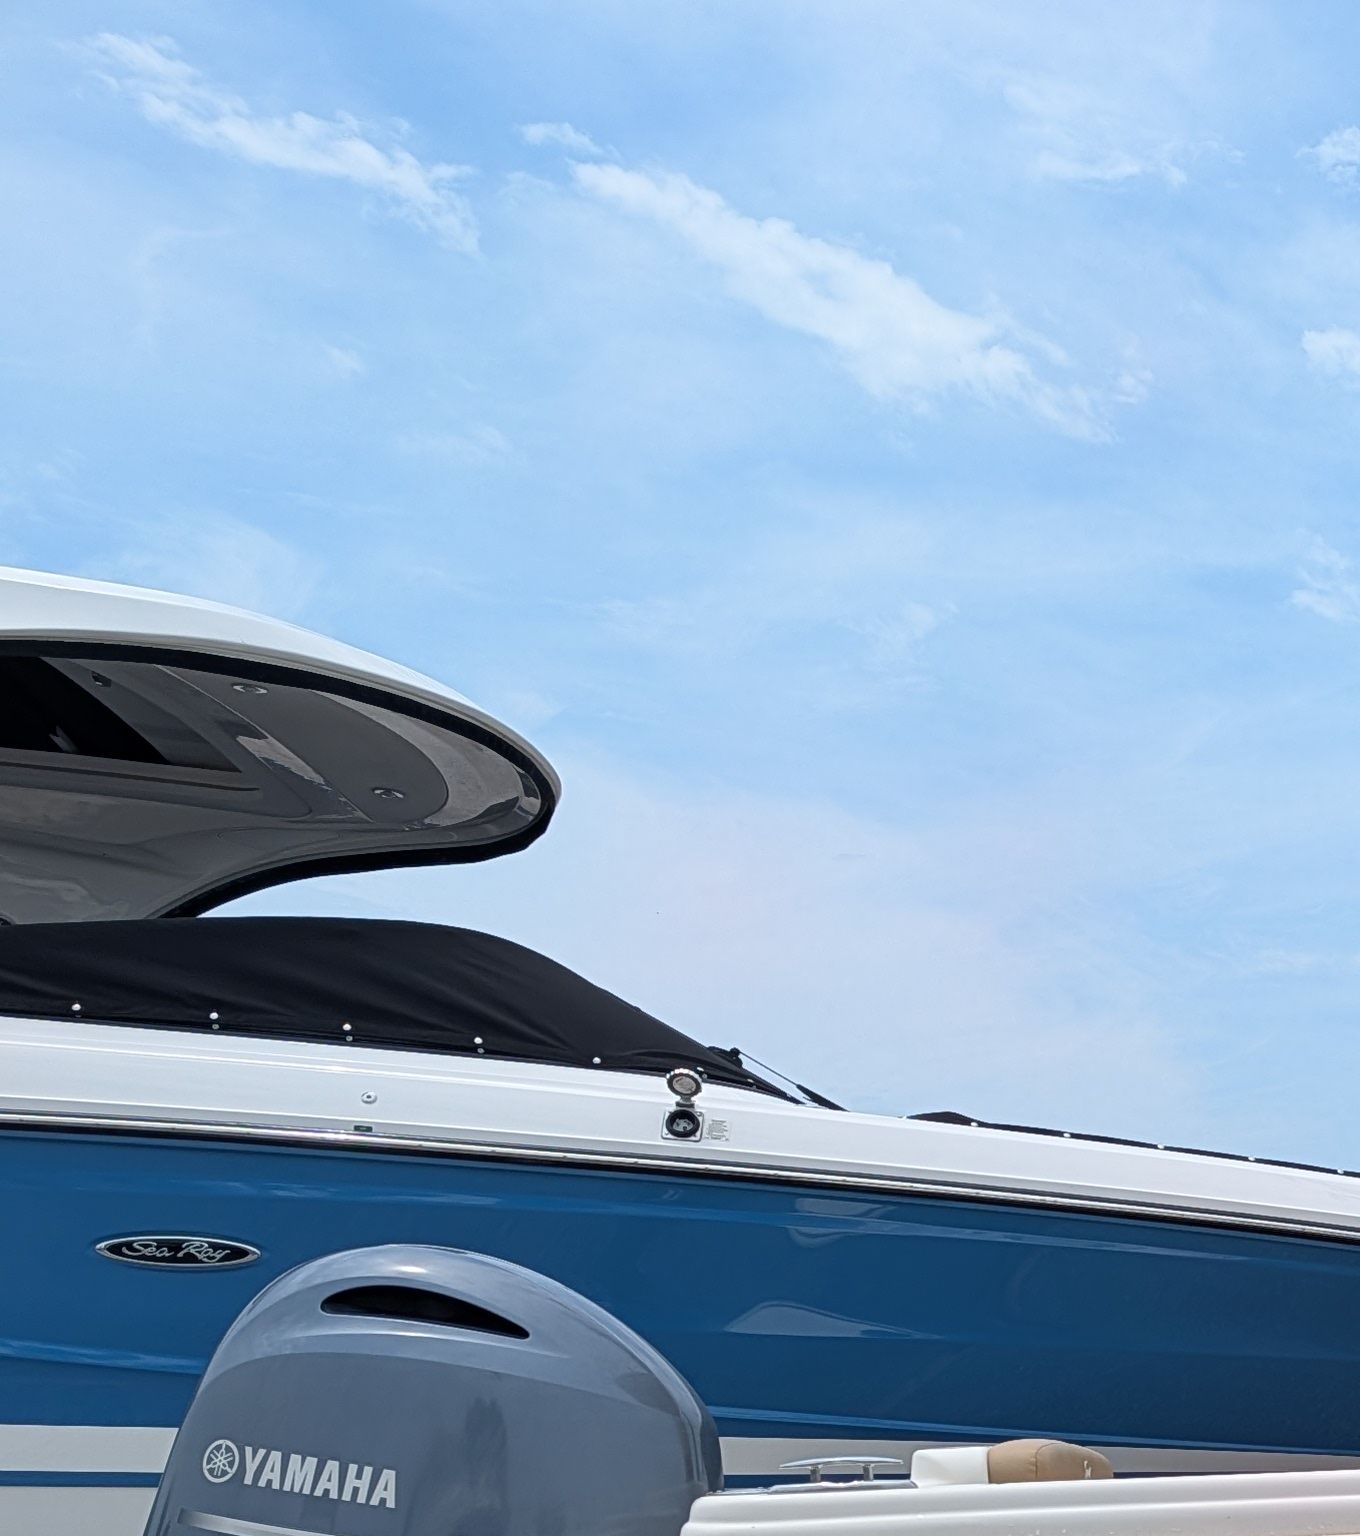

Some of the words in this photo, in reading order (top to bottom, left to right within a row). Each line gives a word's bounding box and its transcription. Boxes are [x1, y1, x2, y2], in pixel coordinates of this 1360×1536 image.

[121, 1241, 175, 1258] Sea
[176, 1241, 231, 1263] Ray
[243, 1446, 396, 1509] YAMAHA
